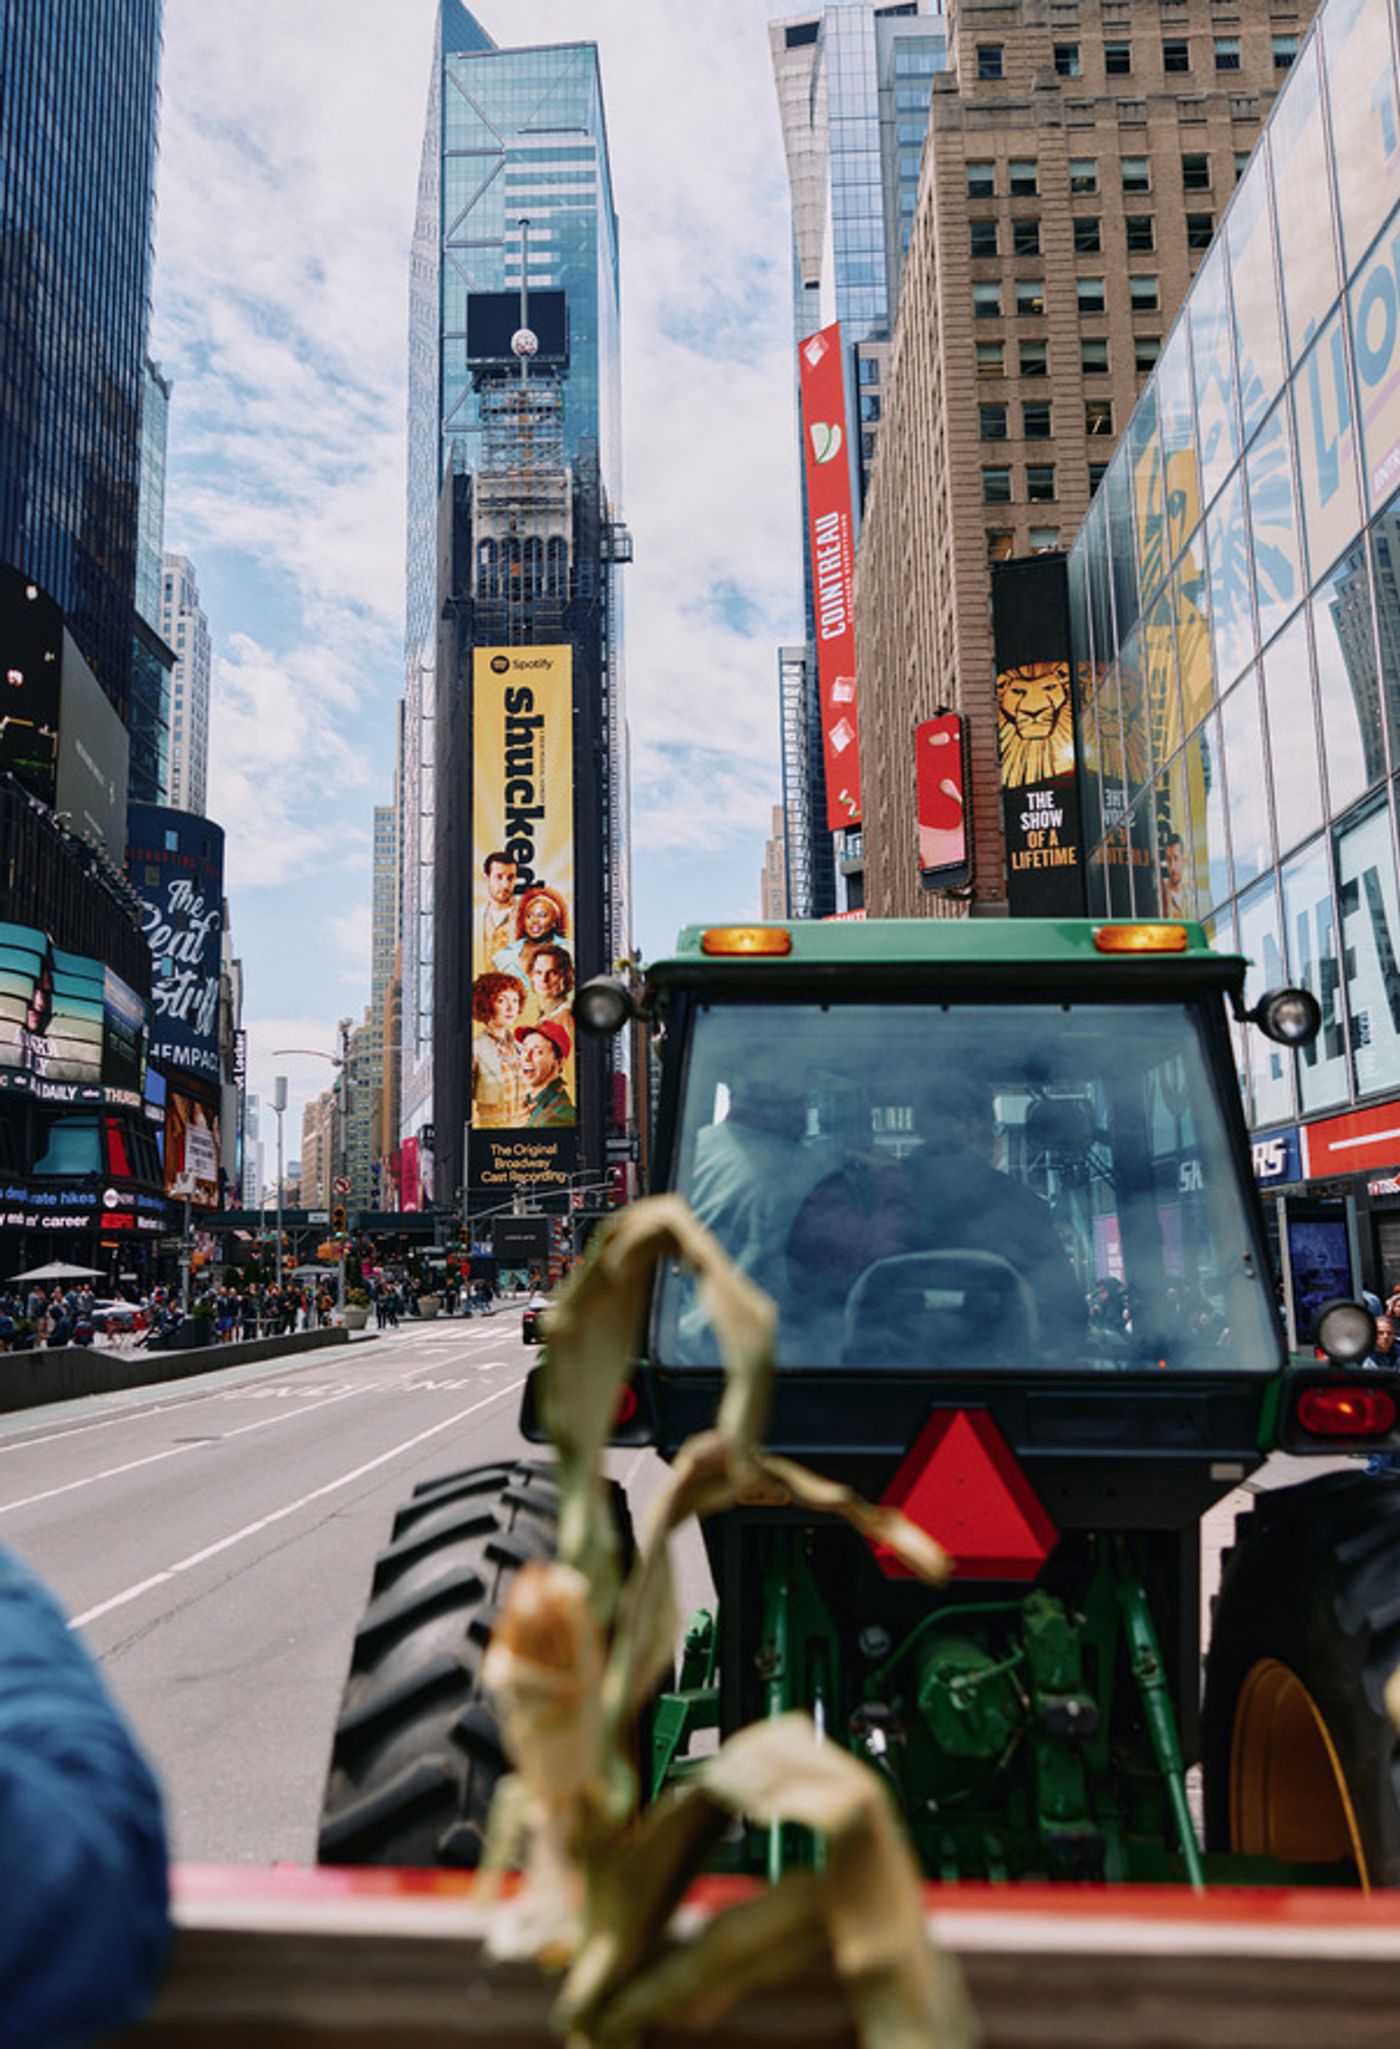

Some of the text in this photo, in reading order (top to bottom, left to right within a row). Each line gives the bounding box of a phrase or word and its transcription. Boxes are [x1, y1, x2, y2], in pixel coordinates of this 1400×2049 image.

[1304, 232, 1400, 510] LIO
[815, 510, 846, 641] COINTREAU
[512, 657, 554, 671] Spotify
[1026, 791, 1055, 810] THE
[1020, 809, 1063, 831] SHOW
[1027, 829, 1059, 848] OF A
[1011, 847, 1077, 870] LIFETIME
[167, 879, 204, 918] The
[41, 1083, 78, 1101] DAILY
[489, 1142, 558, 1157] The Original
[494, 1156, 551, 1170] Broadway
[481, 1170, 567, 1184] Cast Recording
[60, 1191, 97, 1205] hikes
[42, 1215, 90, 1229] career
